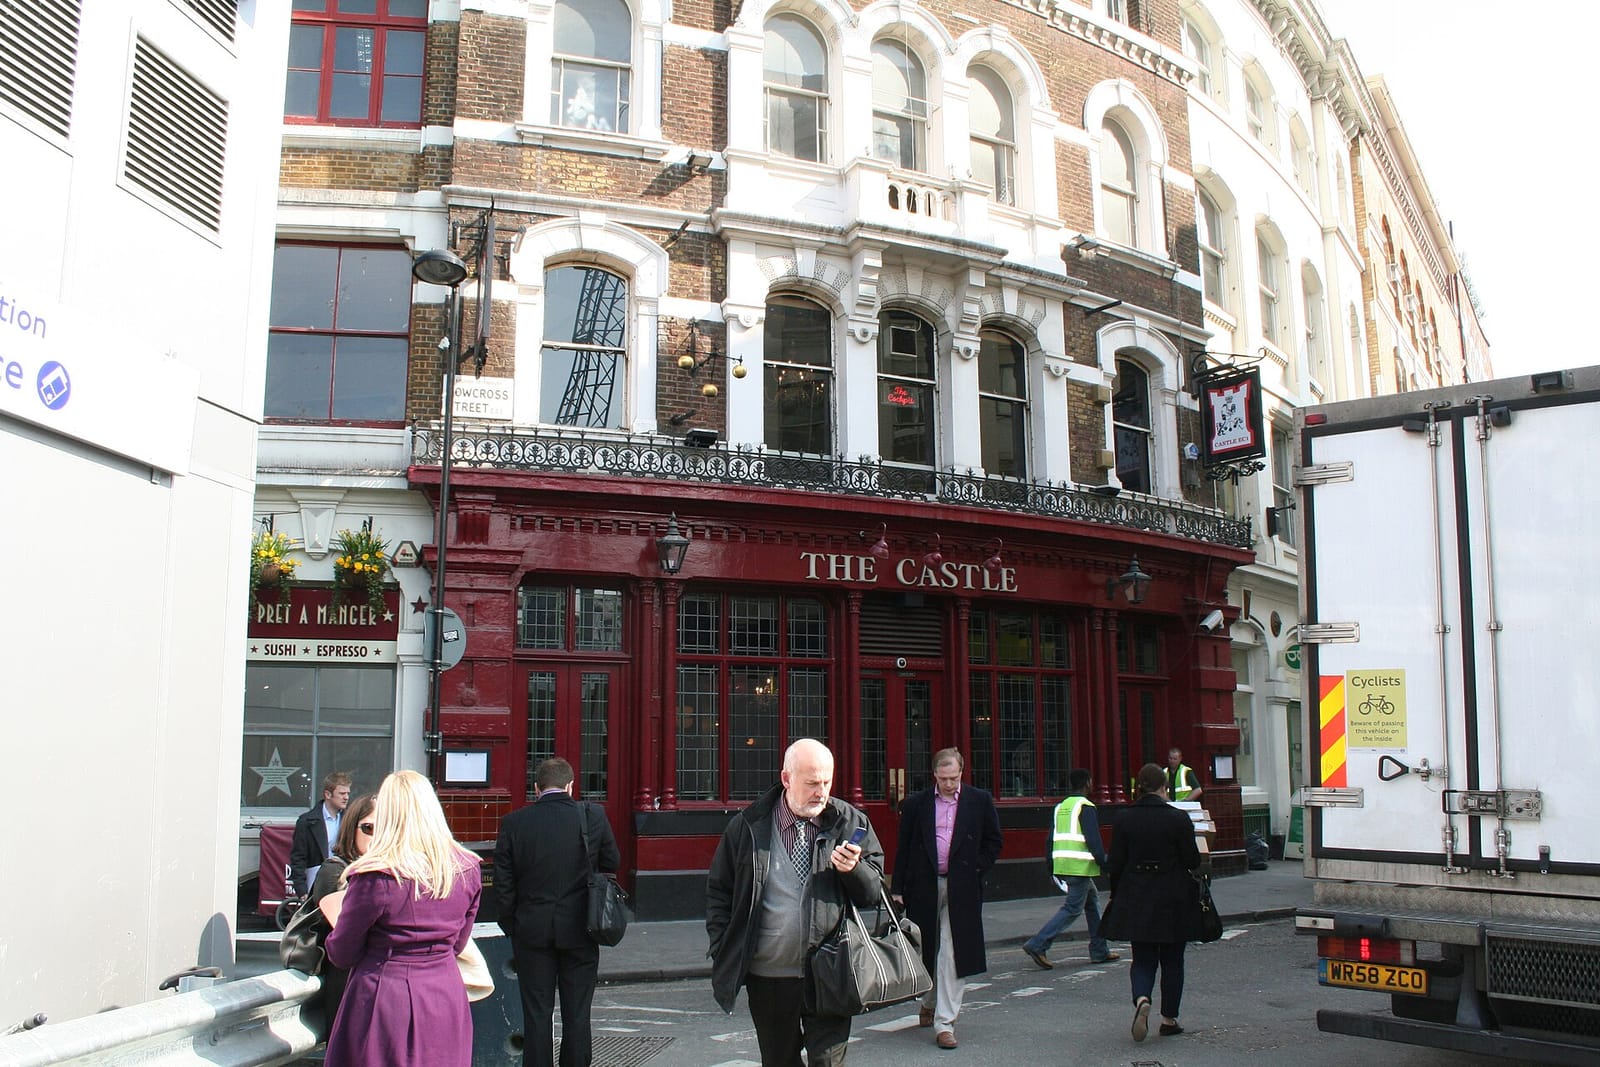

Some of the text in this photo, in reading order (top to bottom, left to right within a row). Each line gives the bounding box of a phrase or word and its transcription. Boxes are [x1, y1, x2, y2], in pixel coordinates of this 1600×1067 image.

[0, 355, 23, 389] e
[455, 387, 509, 400] OWCROSS
[455, 401, 489, 413] TREET
[1214, 438, 1238, 448] CASTLE
[800, 552, 1018, 593] THE CASTLE
[257, 604, 291, 624] PRET
[299, 604, 309, 625] A
[264, 644, 368, 657] SUSHI ESPRESSO
[1351, 676, 1401, 689] Cyclists
[1331, 962, 1422, 989] WR58 ZCO
